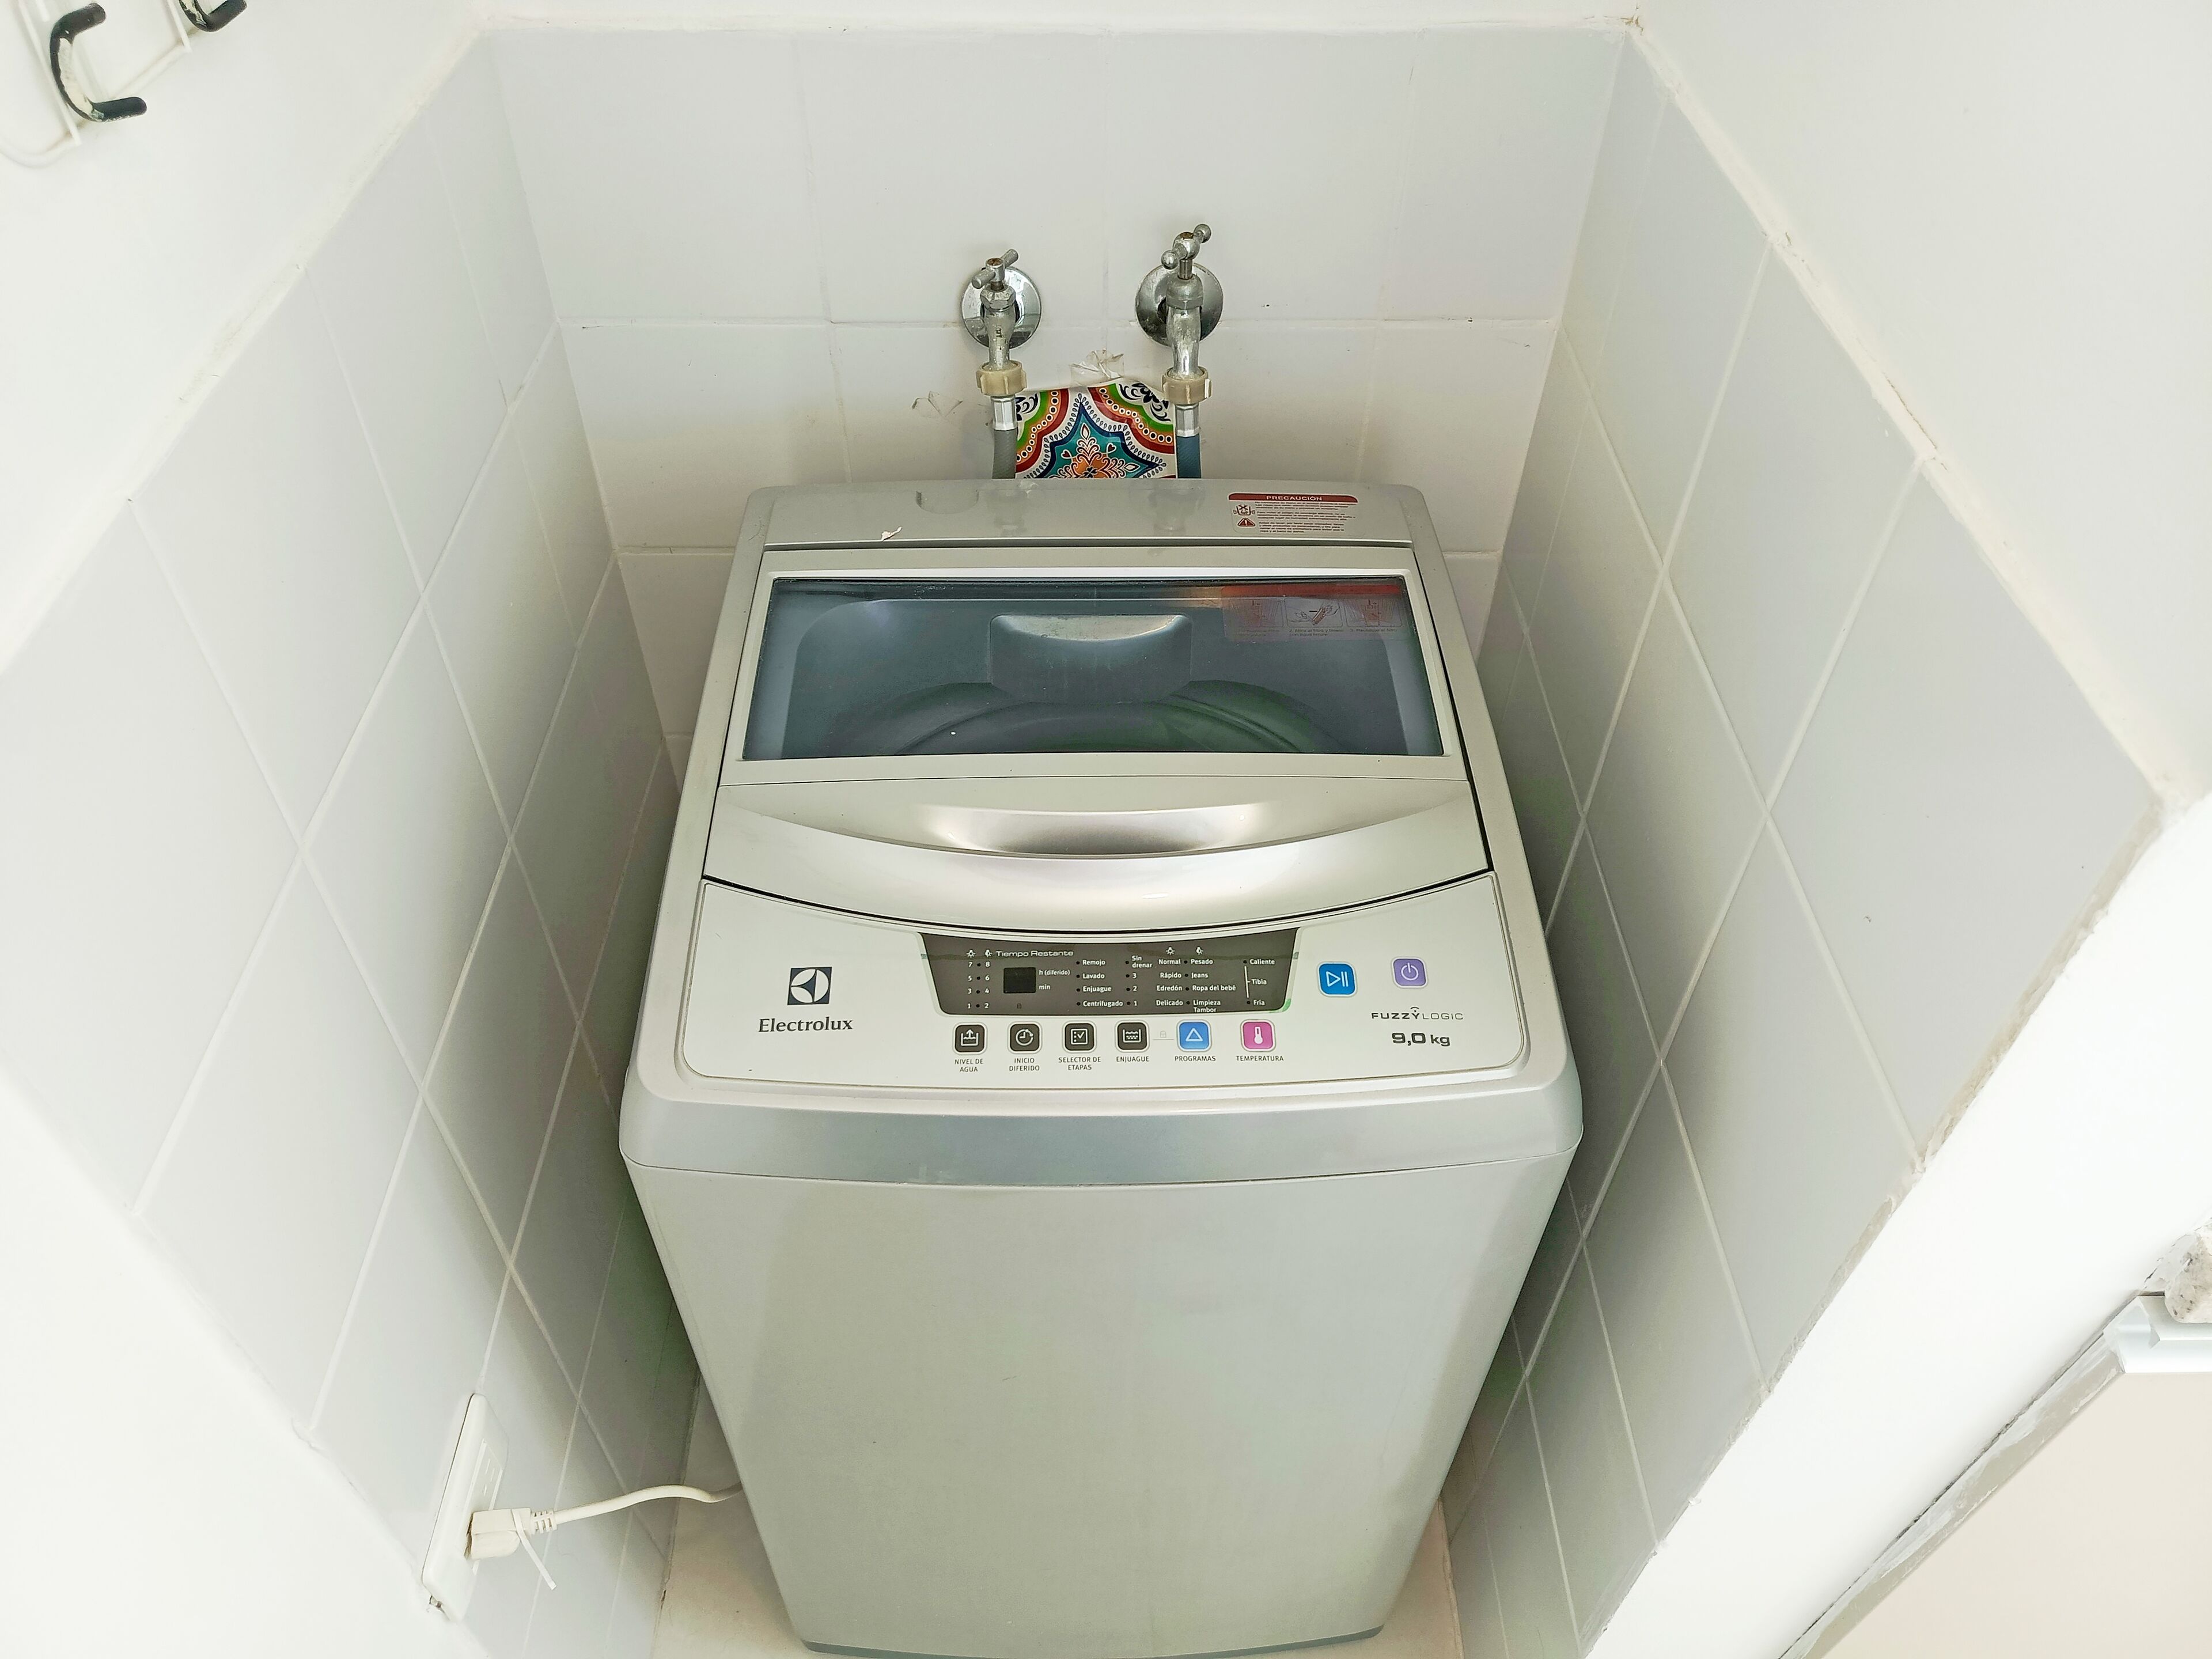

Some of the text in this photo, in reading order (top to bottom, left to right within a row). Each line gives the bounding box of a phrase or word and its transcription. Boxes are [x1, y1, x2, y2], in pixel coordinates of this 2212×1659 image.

[759, 1017, 853, 1032] Electrolux
[1392, 1032, 1450, 1047] 9,0 kg
